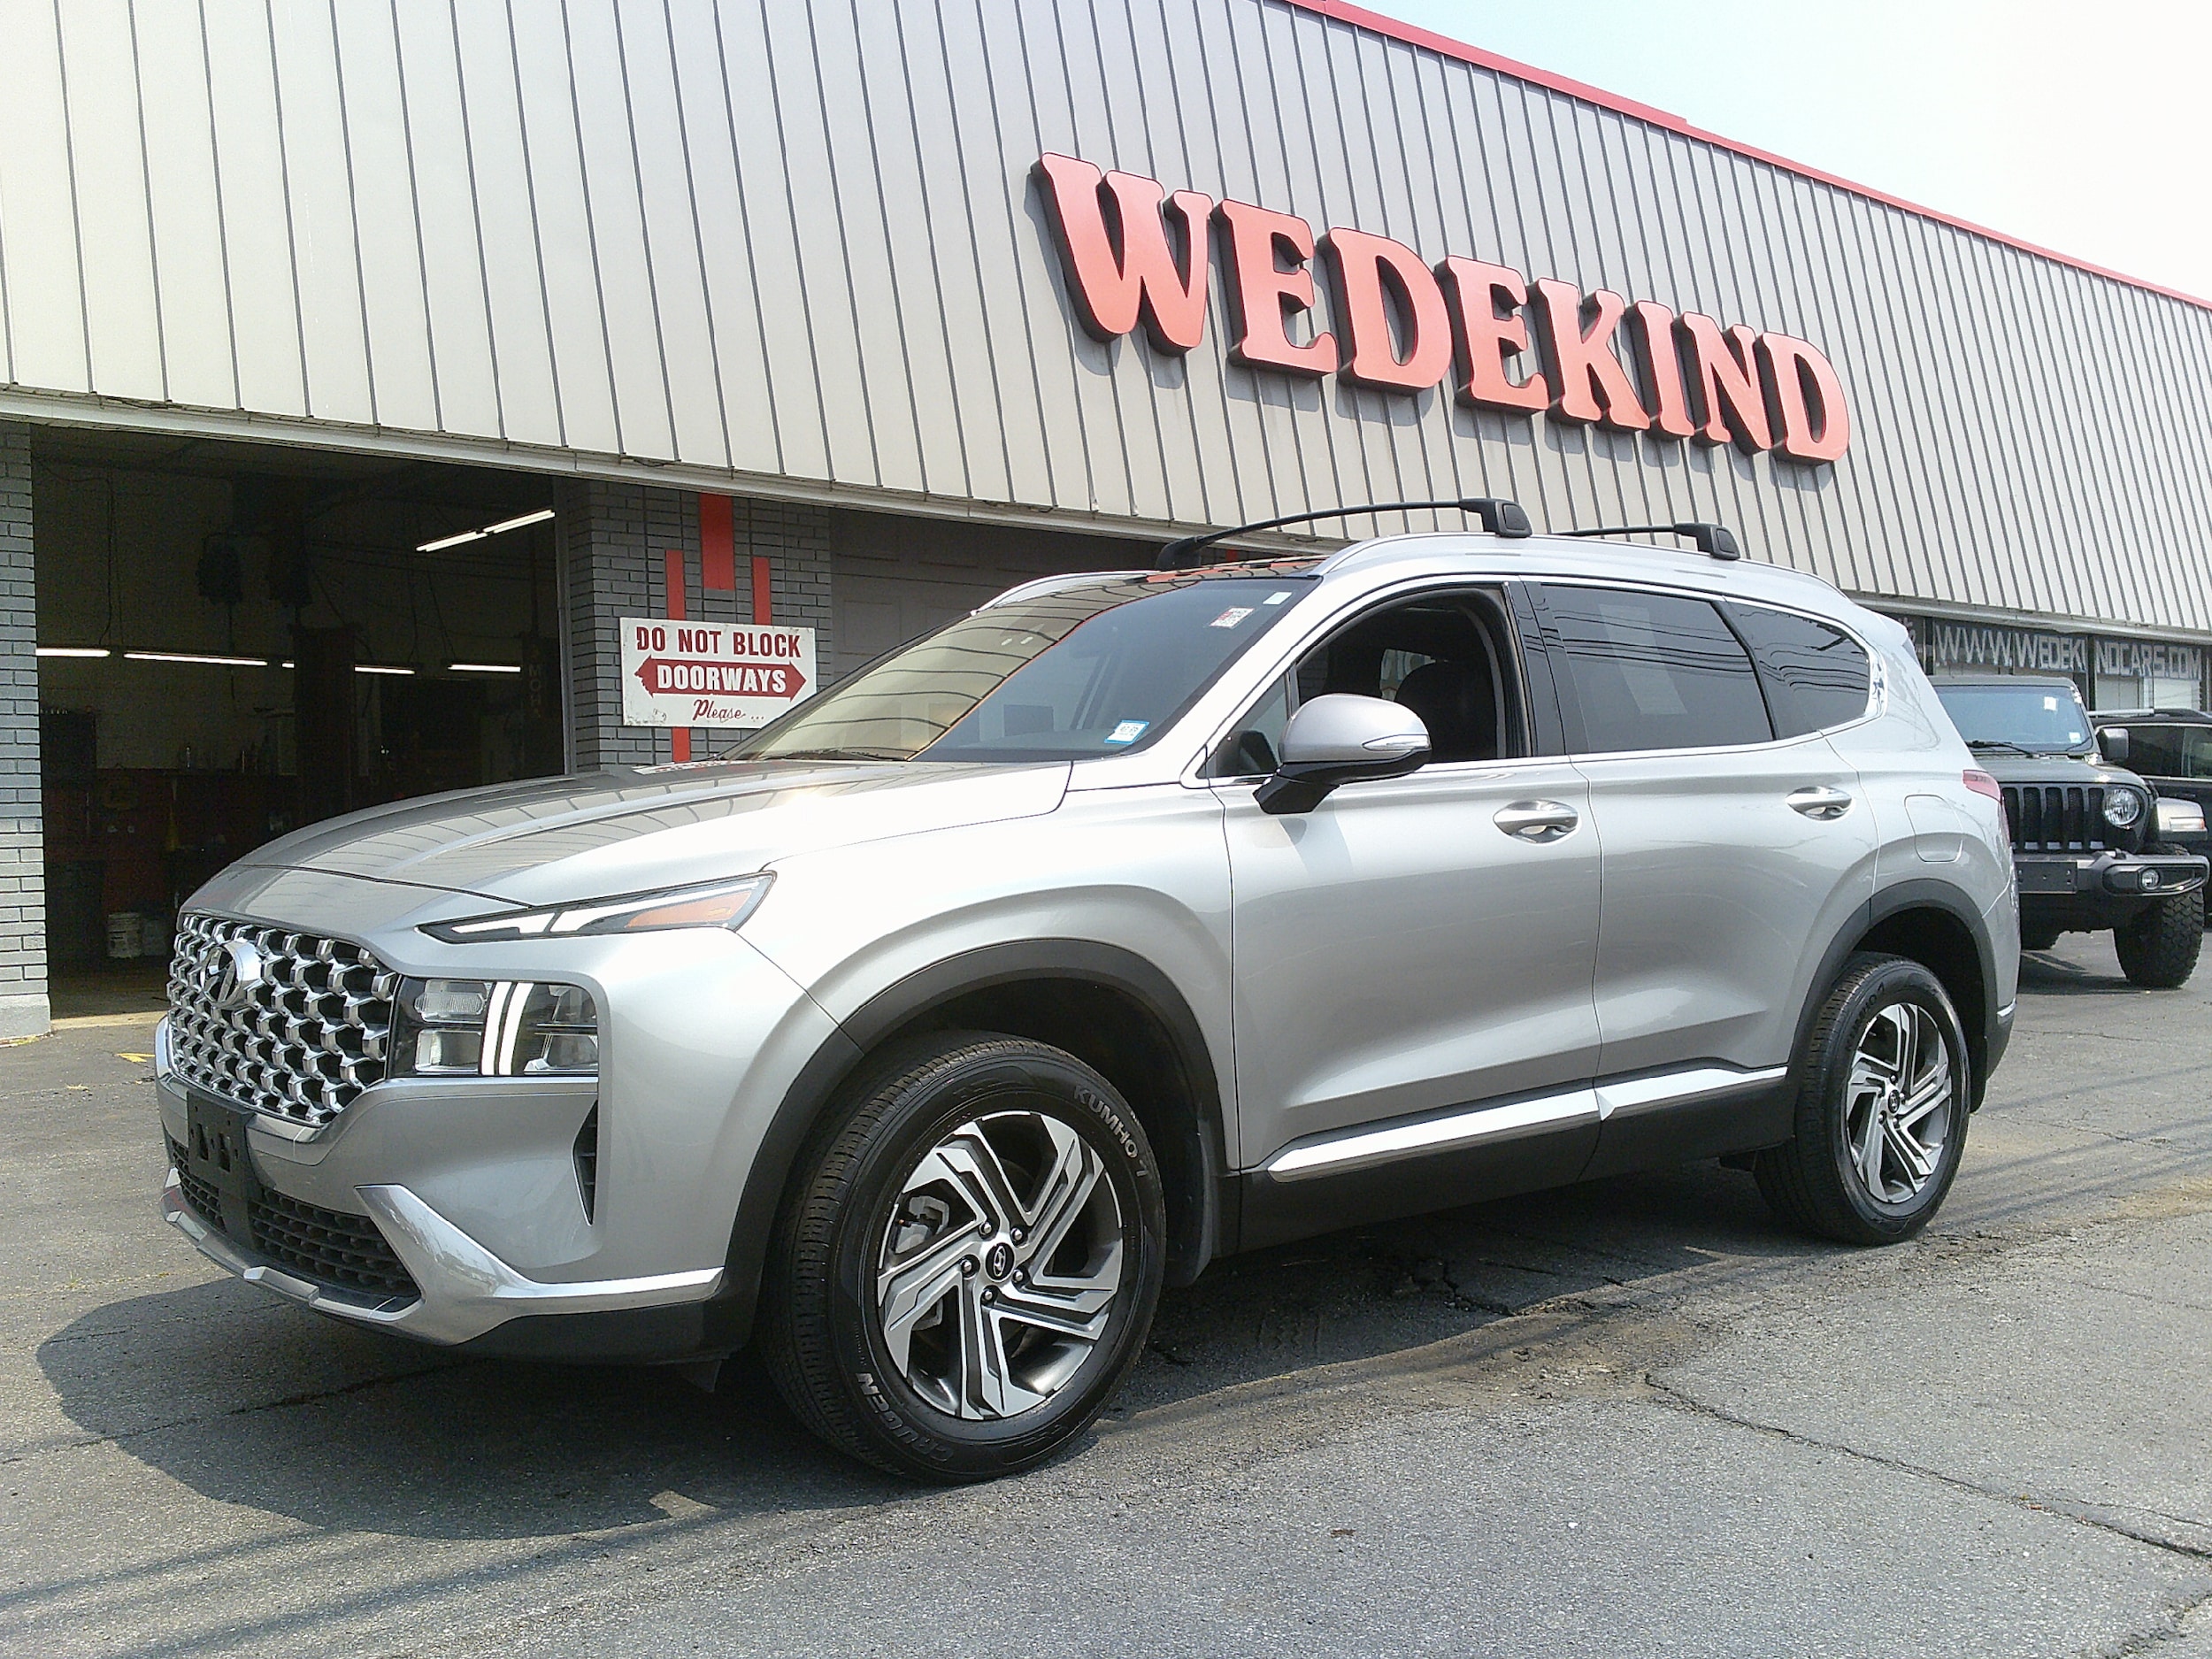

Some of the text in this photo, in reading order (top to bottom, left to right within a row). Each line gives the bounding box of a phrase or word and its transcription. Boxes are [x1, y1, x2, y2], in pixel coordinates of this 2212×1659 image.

[1031, 152, 1850, 465] WEDEKIND
[636, 626, 802, 657] DO NOT BLOCK
[657, 664, 787, 693] DOORWAYS
[1073, 1084, 1139, 1158] KUMHO
